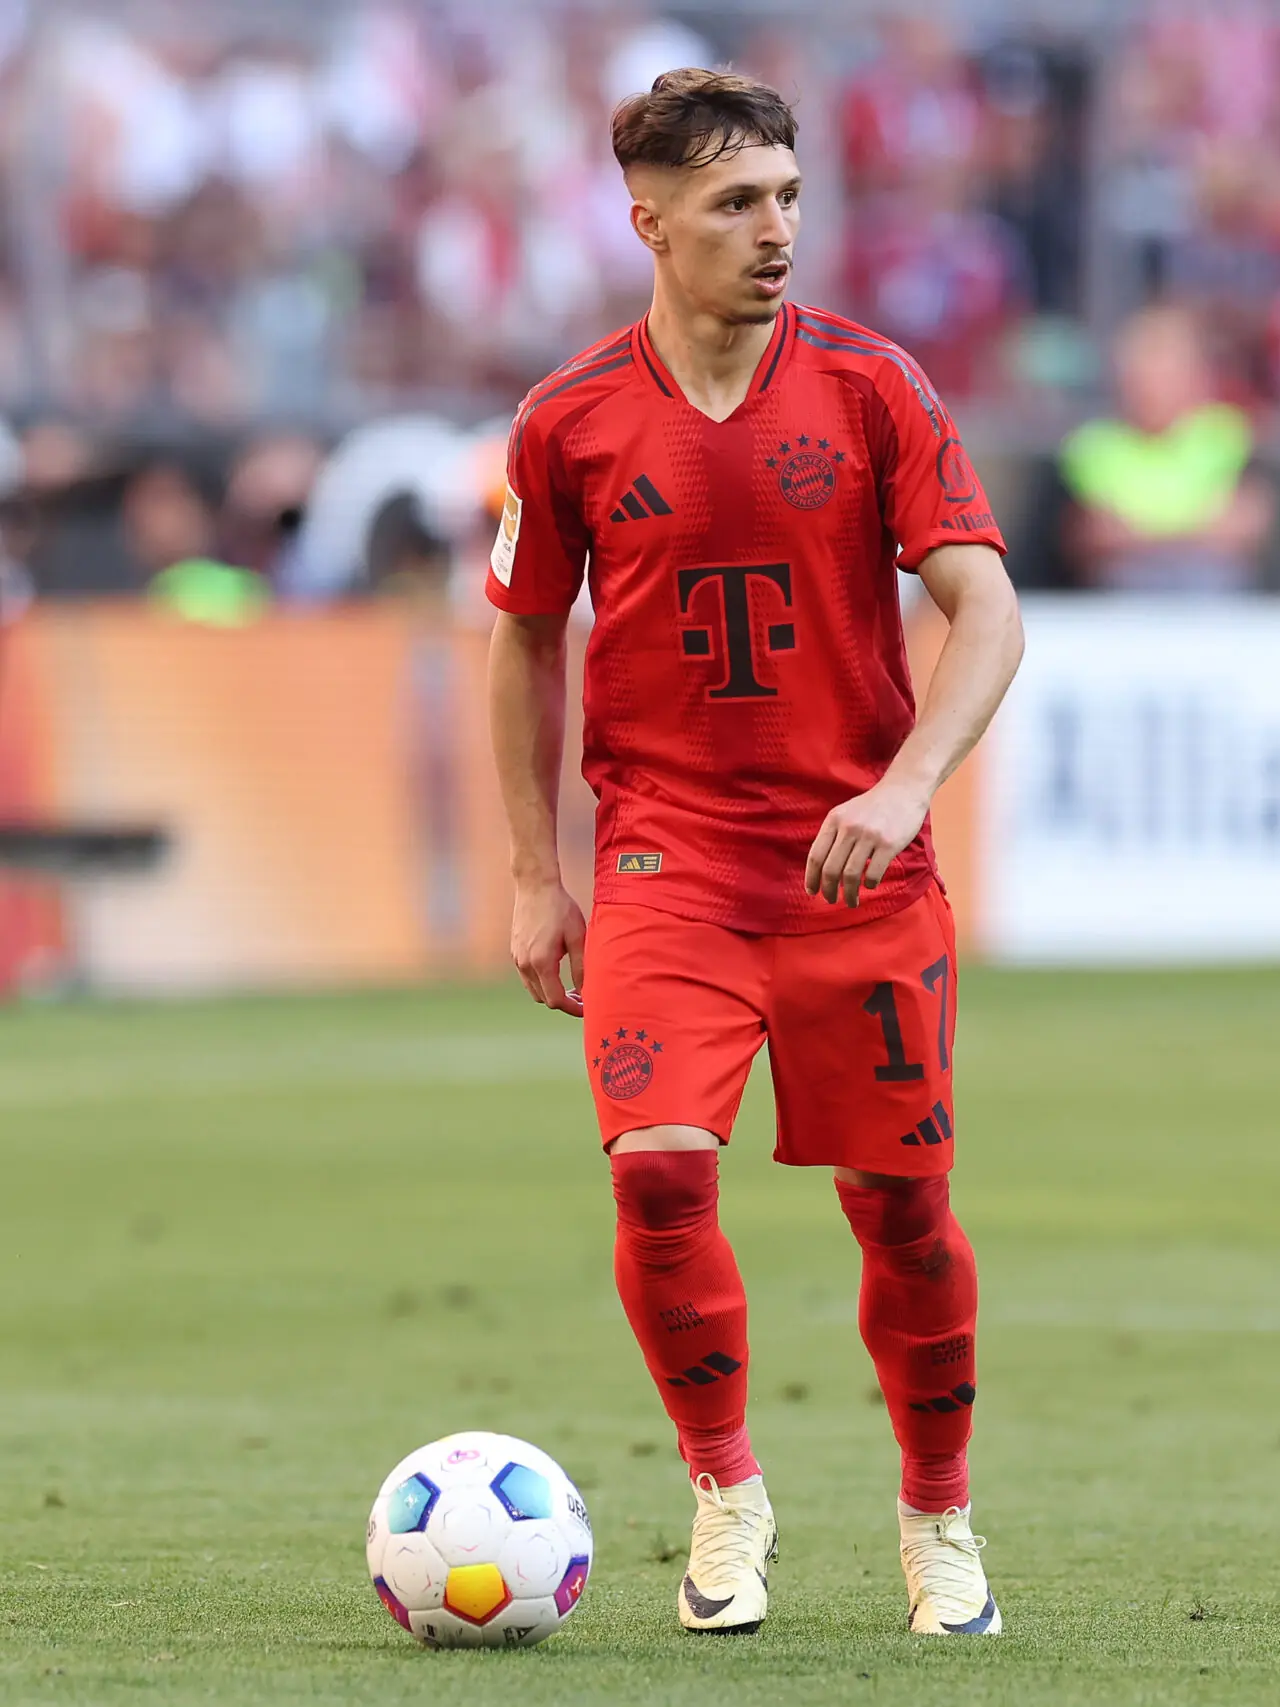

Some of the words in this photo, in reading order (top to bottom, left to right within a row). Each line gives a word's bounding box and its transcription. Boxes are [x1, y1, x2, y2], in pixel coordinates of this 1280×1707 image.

[793, 455, 832, 475] BAYERN
[940, 511, 998, 532] Allian
[677, 562, 796, 699] T
[862, 953, 950, 1082] 17
